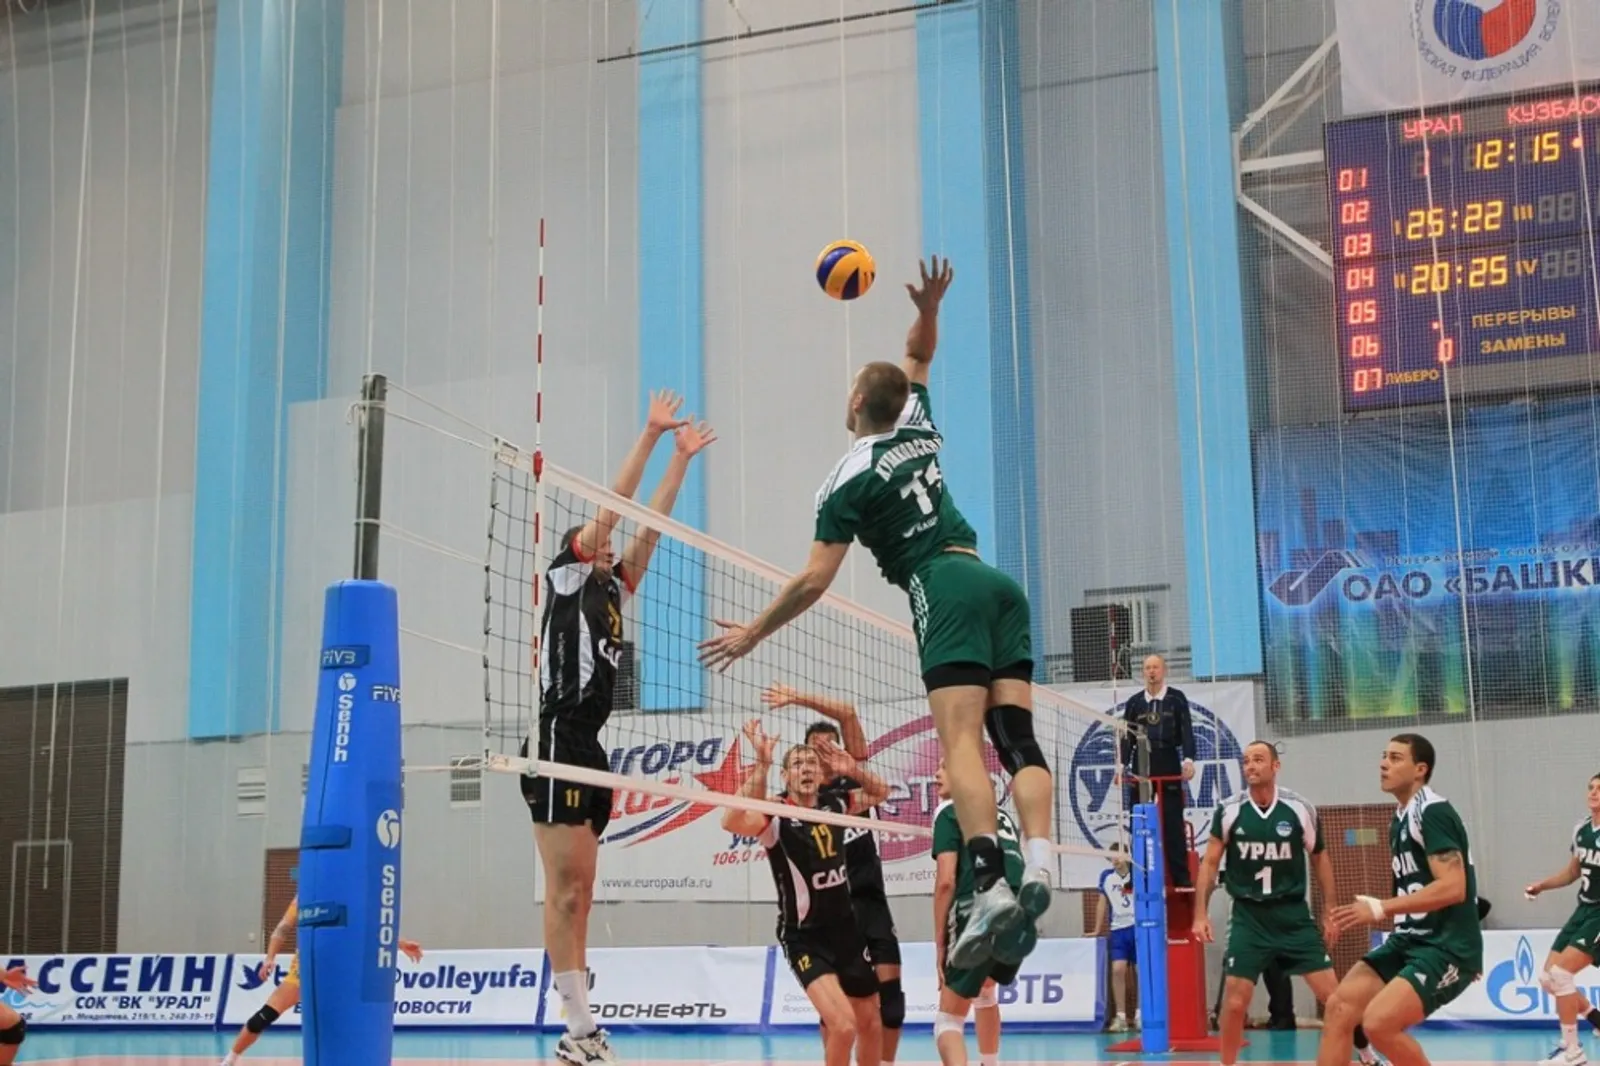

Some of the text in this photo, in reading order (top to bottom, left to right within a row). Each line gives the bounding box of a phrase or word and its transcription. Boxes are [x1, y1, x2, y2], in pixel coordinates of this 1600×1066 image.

[1404, 113, 1463, 138] УРАЛ
[1340, 168, 1367, 191] 01
[1342, 201, 1369, 224] 02
[1344, 233, 1372, 257] 03
[1346, 267, 1374, 290] 04
[1348, 300, 1376, 324] 05
[1472, 305, 1576, 328] ПЕРЕРЫВЫ
[1480, 333, 1566, 354] ЗАМЕНЫ
[1353, 368, 1382, 392] 07
[1385, 369, 1439, 385] ЛИБЕРО
[1343, 571, 1432, 602] ОАО
[566, 789, 580, 808] 11
[811, 824, 837, 859] 12
[1237, 842, 1292, 860] УРАЛ
[602, 876, 713, 890] www.europaufa.ru
[1254, 866, 1273, 895] 1
[798, 955, 813, 972] 12
[75, 996, 107, 1009] СОК
